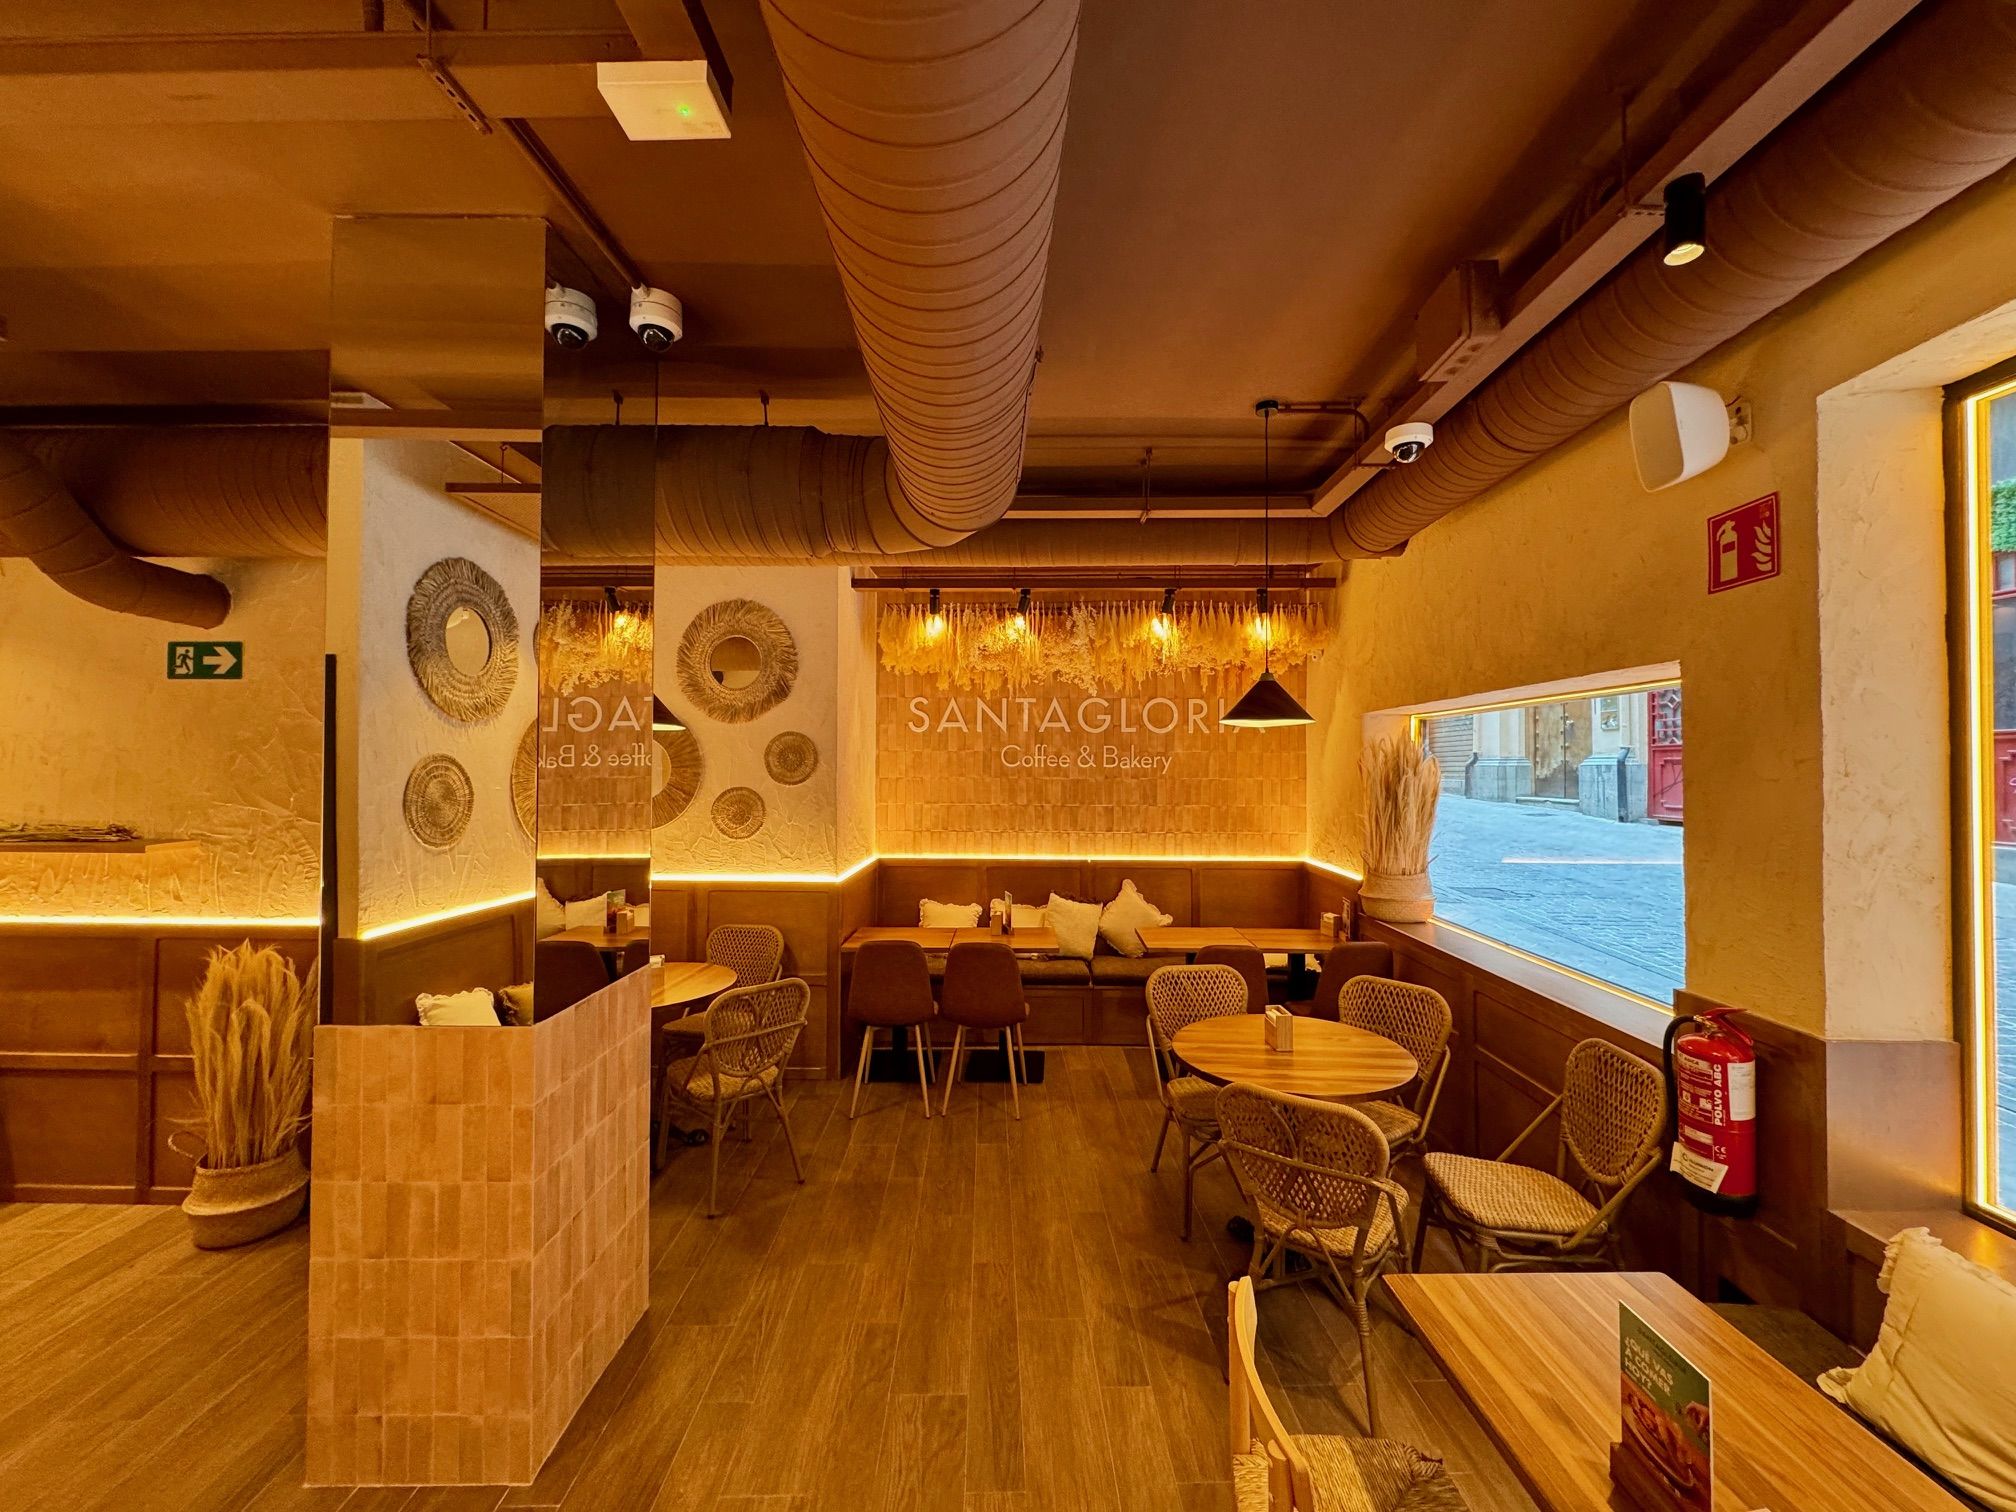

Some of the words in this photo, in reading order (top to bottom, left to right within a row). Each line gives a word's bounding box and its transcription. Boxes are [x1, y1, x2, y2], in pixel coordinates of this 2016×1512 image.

[907, 696, 1266, 734] SANTAGLORI
[1001, 744, 1070, 769] Coffee
[1077, 745, 1097, 769] &
[1103, 744, 1172, 775] Bakery
[1713, 1064, 1722, 1087] ABC
[1713, 1089, 1723, 1127] POLVO
